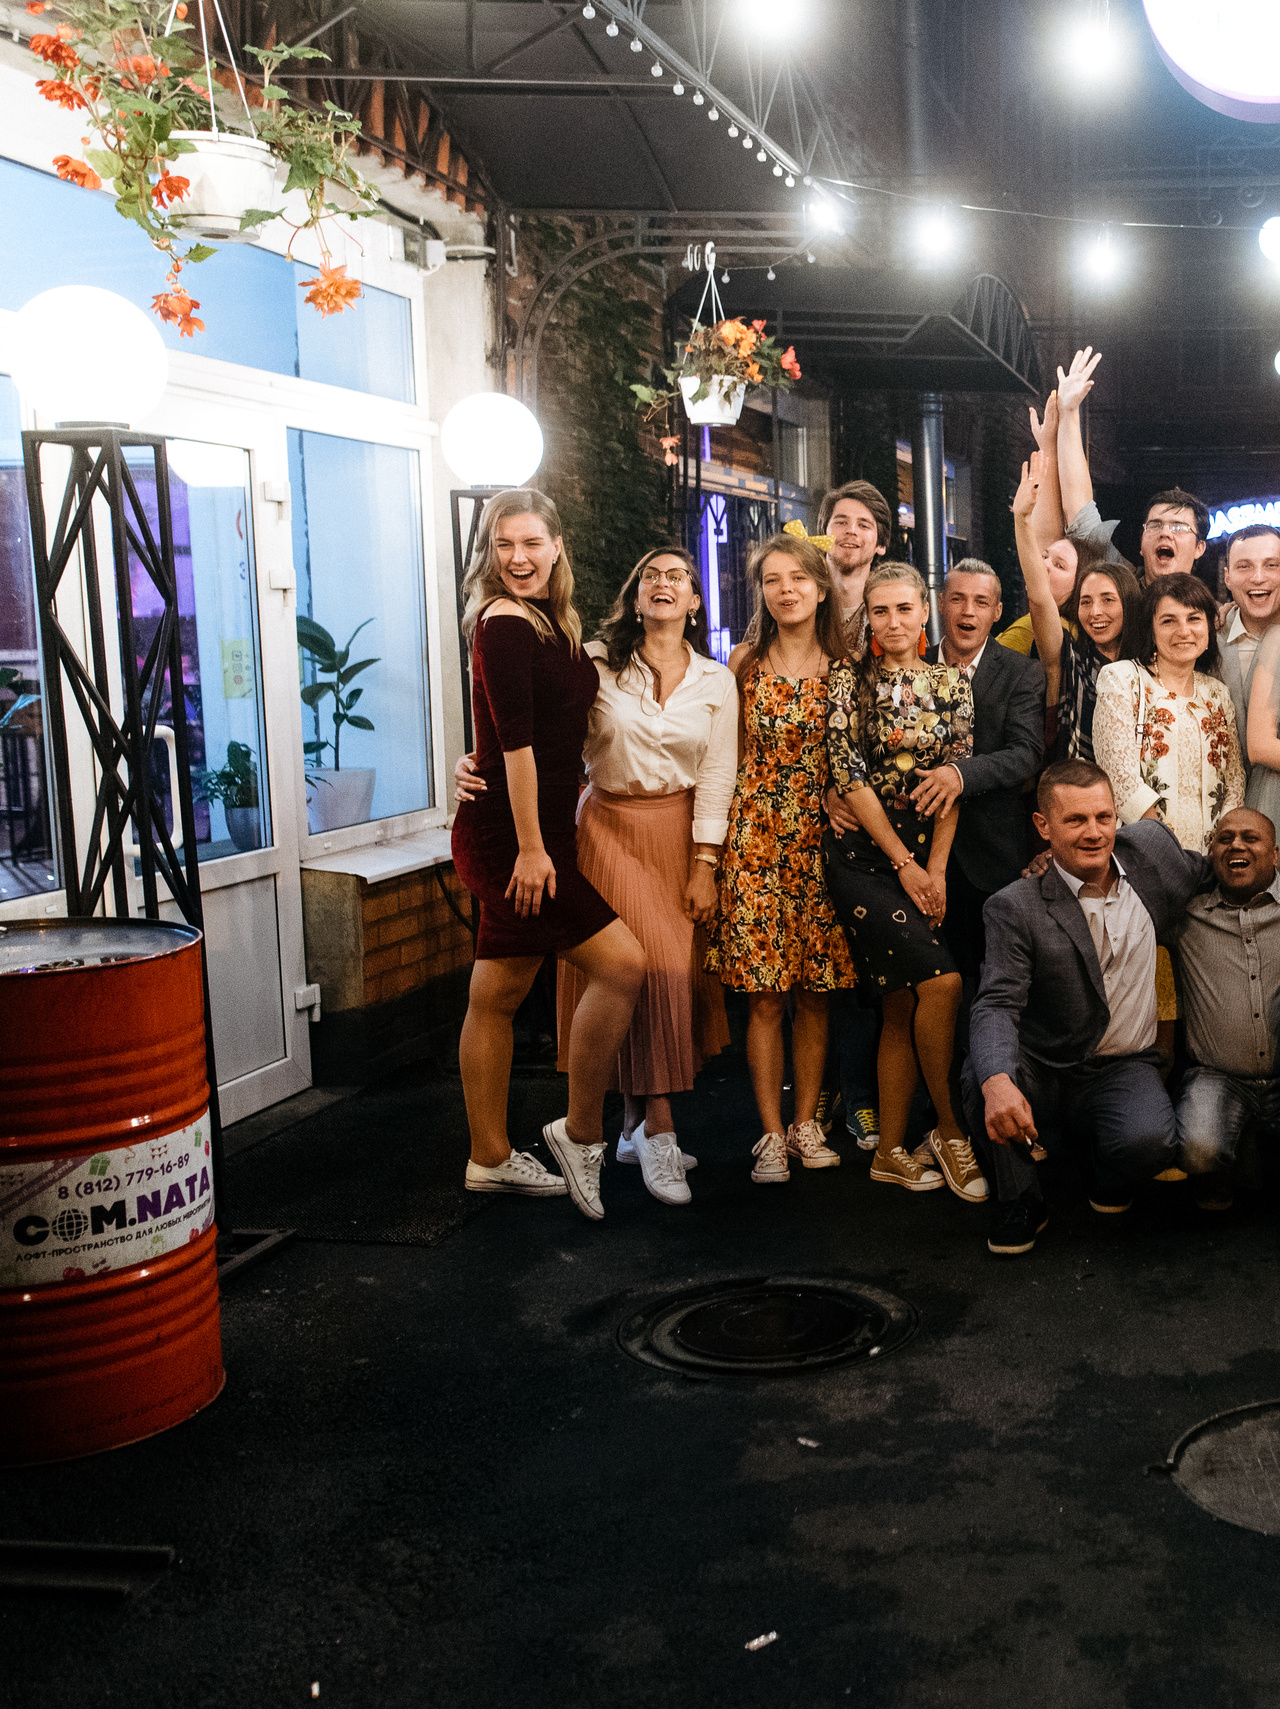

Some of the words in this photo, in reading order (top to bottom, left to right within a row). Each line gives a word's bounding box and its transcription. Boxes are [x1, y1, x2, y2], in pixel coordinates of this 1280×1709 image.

[58, 1186, 69, 1200] 8
[75, 1176, 121, 1199] (812)
[125, 1153, 190, 1187] 779-16-89
[13, 1166, 211, 1247] COM.NATA
[15, 1233, 133, 1263] ЛОФТ-ПРОСТРАНСТВО
[135, 1227, 154, 1240] ДЛЯ
[154, 1214, 182, 1233] ЛЮБЫХ
